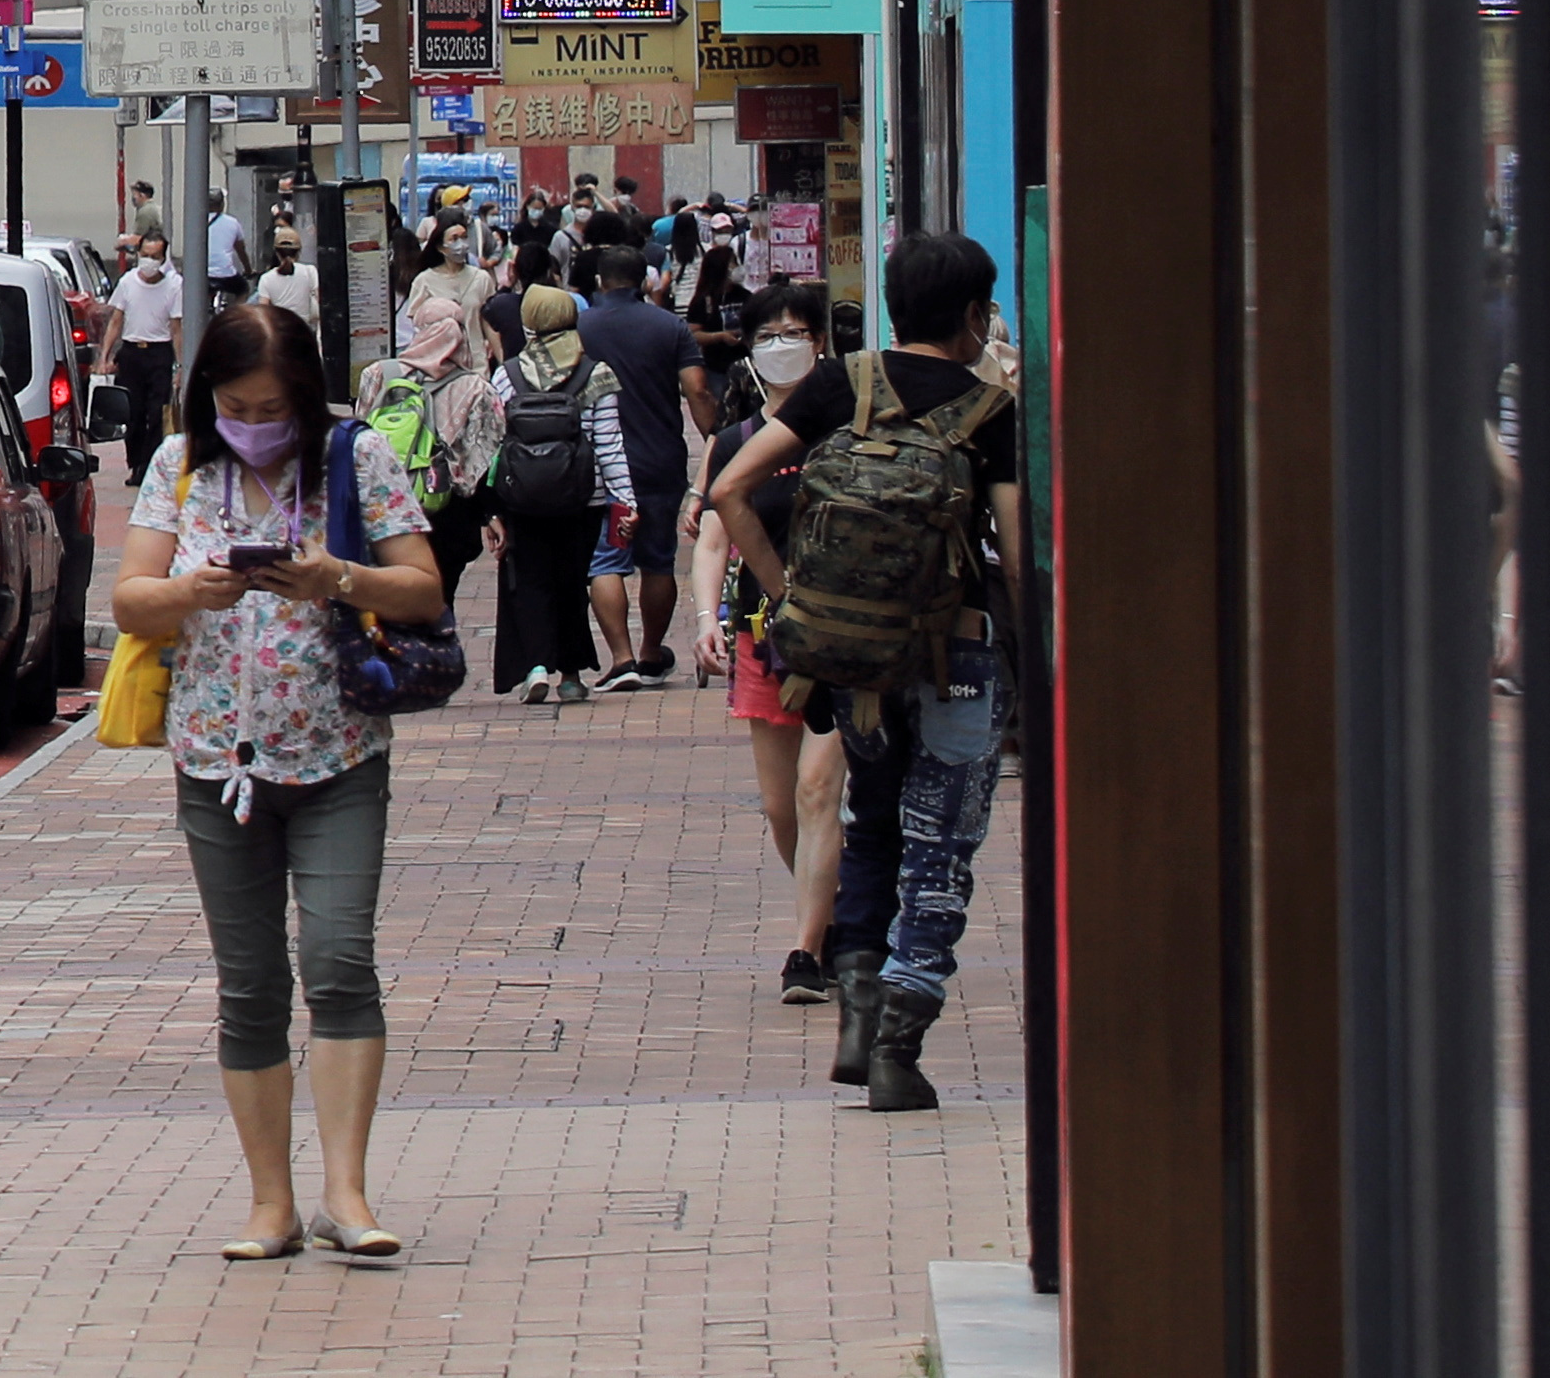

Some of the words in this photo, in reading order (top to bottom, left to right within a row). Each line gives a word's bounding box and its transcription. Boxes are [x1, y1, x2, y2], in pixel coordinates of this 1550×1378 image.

[221, 1, 259, 17] trips
[264, 0, 298, 17] only
[129, 19, 178, 36] single
[182, 18, 211, 33] toll
[215, 17, 270, 34] charge
[425, 36, 487, 61] 95320835
[531, 67, 585, 77] INSTANT
[594, 65, 675, 75] INSPIRATION
[491, 92, 690, 140] 名錶維修中心
